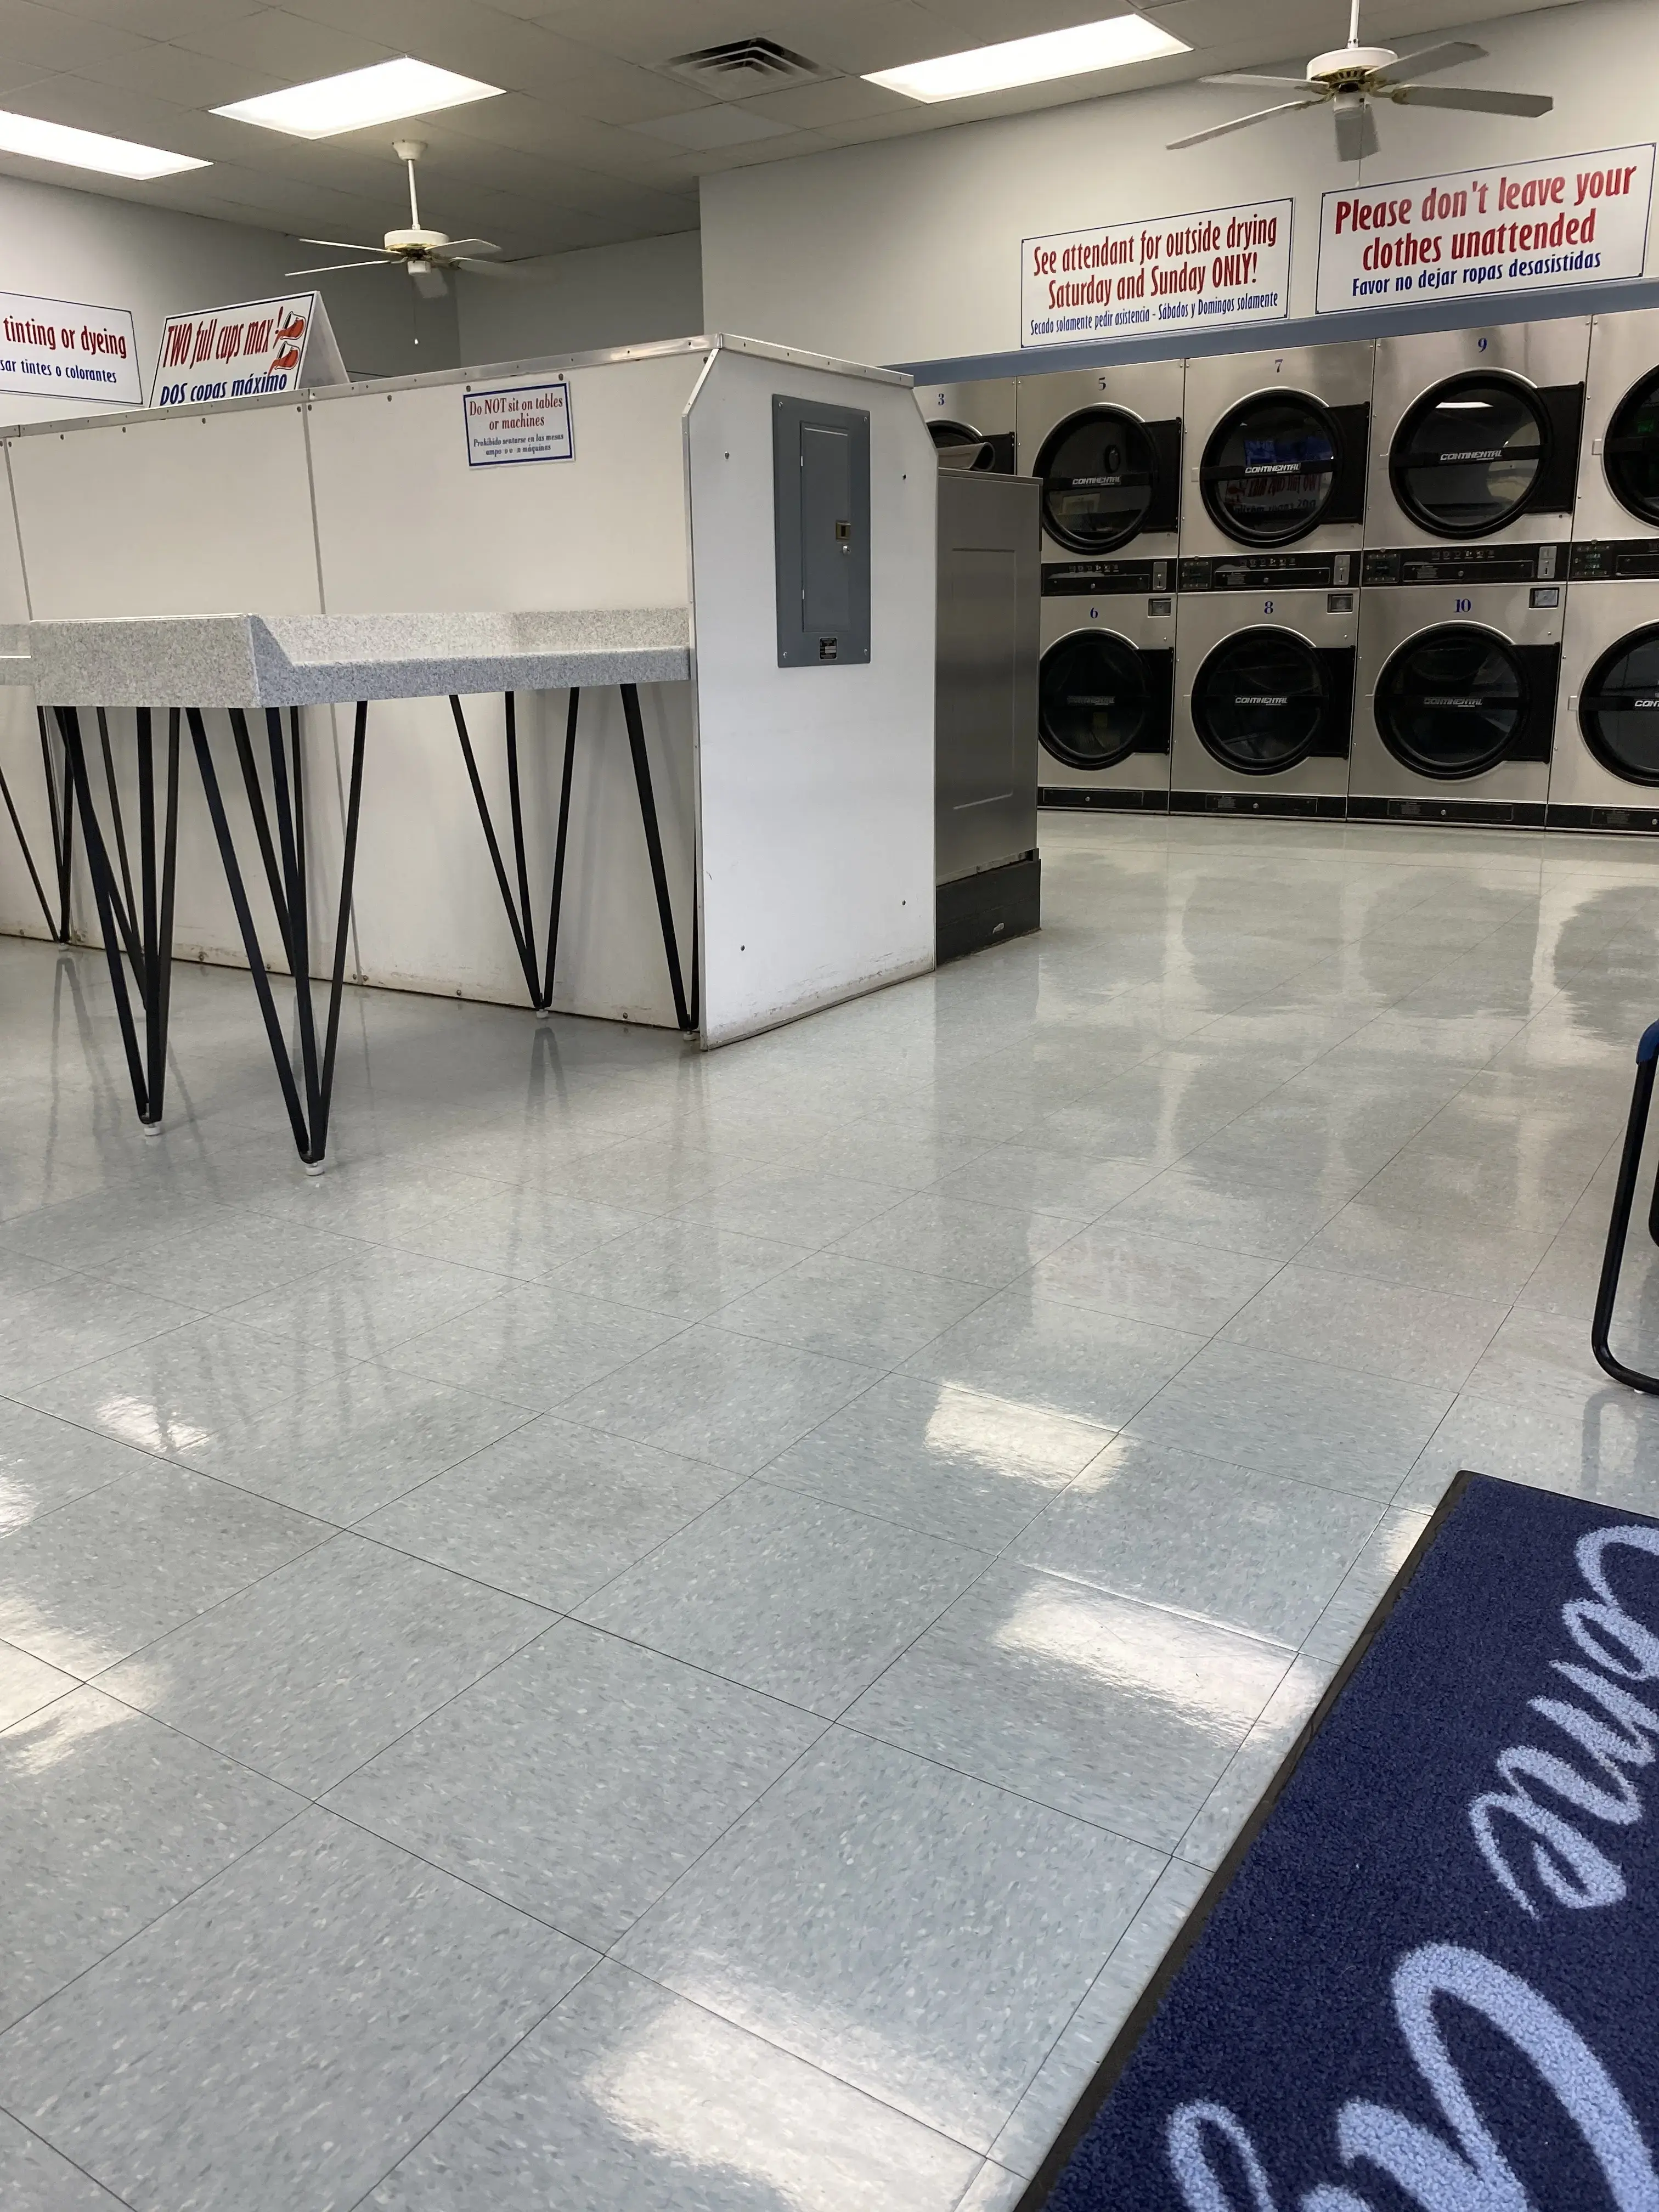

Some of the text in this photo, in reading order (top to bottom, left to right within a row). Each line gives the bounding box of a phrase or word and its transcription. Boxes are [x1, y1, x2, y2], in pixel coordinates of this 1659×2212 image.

[1335, 165, 1637, 234] Please don't leave your
[1034, 214, 1277, 276] See attendant for outside drying
[1363, 208, 1595, 271] clothes unattended
[1049, 252, 1257, 309] Saturday and Sunday ONLY!
[1352, 250, 1601, 297] Favor no dejar ropas desasistidas
[1030, 319, 1053, 335] Secado
[1056, 314, 1092, 332] solamente
[1095, 310, 1113, 330] pedir
[1115, 306, 1150, 325] asistencia
[1158, 302, 1188, 320] Sábados
[1191, 304, 1195, 319] y
[1198, 297, 1234, 316] Domingos
[1237, 292, 1278, 311] solamente
[3, 315, 127, 359] tinting or dyeing
[162, 325, 192, 368] TWO
[189, 317, 218, 369] full
[215, 321, 244, 364] cups
[1477, 338, 1488, 353] 9
[0, 359, 117, 383] sar tintes o colorantes
[1275, 358, 1283, 373] 7
[160, 373, 287, 407] DOS copas máximo
[1097, 377, 1107, 391] 5
[470, 393, 563, 416] Do NOT sit on tables
[938, 393, 945, 406] 3
[489, 413, 545, 431] or machines
[536, 433, 544, 442] las
[522, 444, 551, 455] máquinas
[1440, 449, 1502, 461] CONTINENTAL
[1245, 464, 1301, 473] CONTINENTAL
[1072, 475, 1121, 485] CONTINENTAL
[1090, 607, 1099, 619] 6
[1264, 601, 1274, 614] 8
[1454, 598, 1471, 613] 10
[1235, 696, 1288, 704] CONTINENTAL
[1424, 697, 1482, 706] CONTINENTAL
